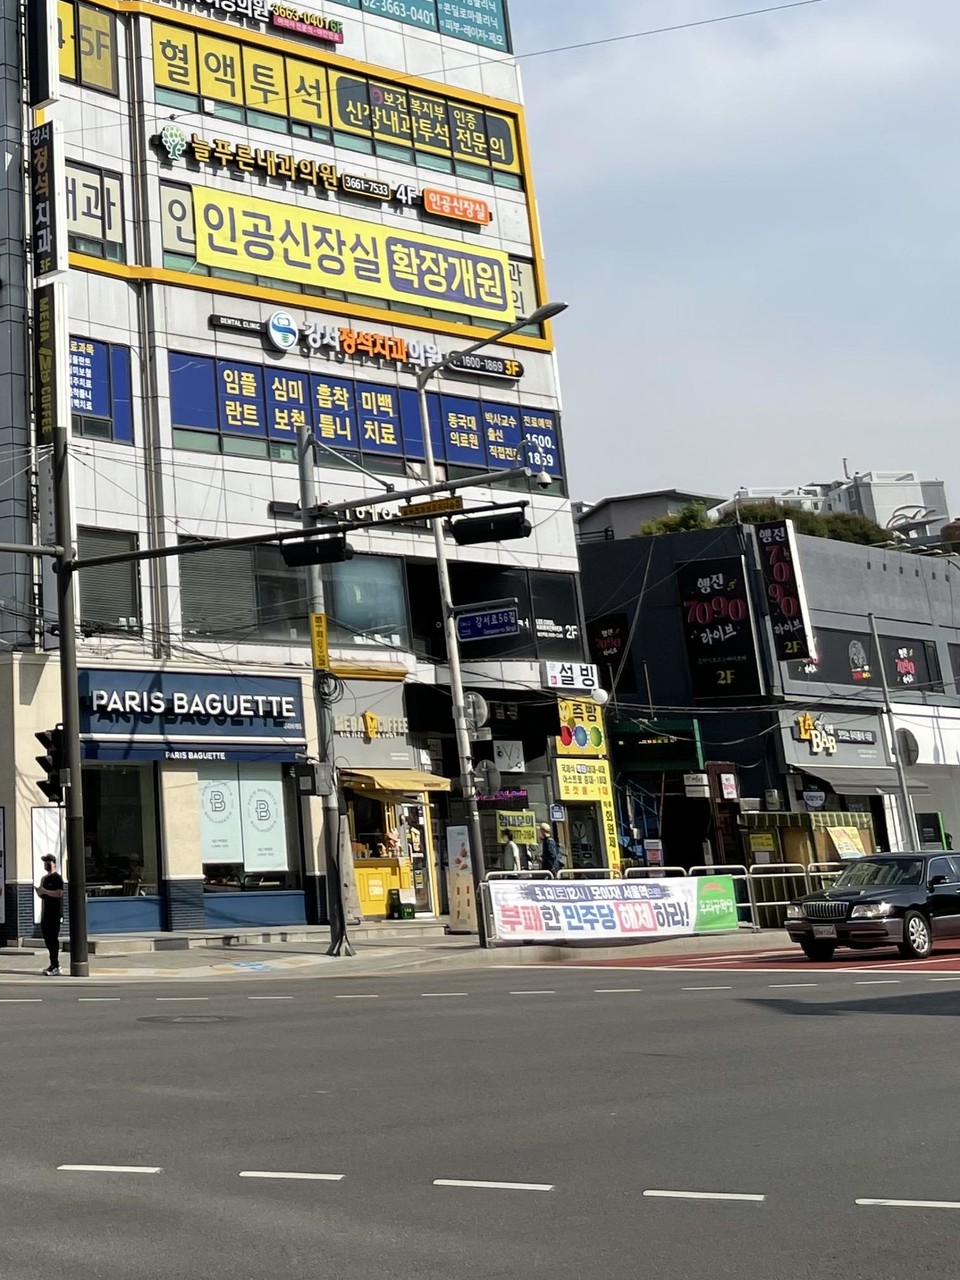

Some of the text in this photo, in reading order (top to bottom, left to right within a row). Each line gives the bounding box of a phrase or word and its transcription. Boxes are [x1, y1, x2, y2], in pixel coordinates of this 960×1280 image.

[273, 4, 329, 30] 3663-0401
[383, 91, 477, 130] 보건복지부 인증
[191, 133, 487, 220] 늘푸른내과의원 3661-7533 4F 인공신장실
[31, 126, 53, 273] 강서 정석치과 3F
[203, 202, 382, 284] 인공신장실
[390, 242, 506, 307] 확장개원
[461, 355, 504, 373] 1600-1869
[505, 359, 520, 376] 3F
[272, 377, 304, 404] 심미
[316, 384, 349, 411] 흡착
[361, 391, 393, 417] 미백
[319, 414, 352, 441] 틀니
[364, 420, 398, 446] 치료
[448, 412, 477, 431] 동국대
[450, 432, 479, 450] 의료원
[697, 573, 724, 594] 행진
[683, 596, 746, 625] 7090
[565, 624, 578, 639] 2F
[700, 624, 738, 645] 라이브
[773, 620, 802, 636] 라이브
[783, 640, 802, 654] 2F
[559, 662, 595, 687] 설빙
[716, 669, 736, 685] 2F
[92, 689, 296, 718] PARIS BAGUETTE
[810, 729, 837, 753] BAB
[165, 751, 226, 760] PARIS BAGUETTE
[499, 903, 615, 933] 부패한 민주당
